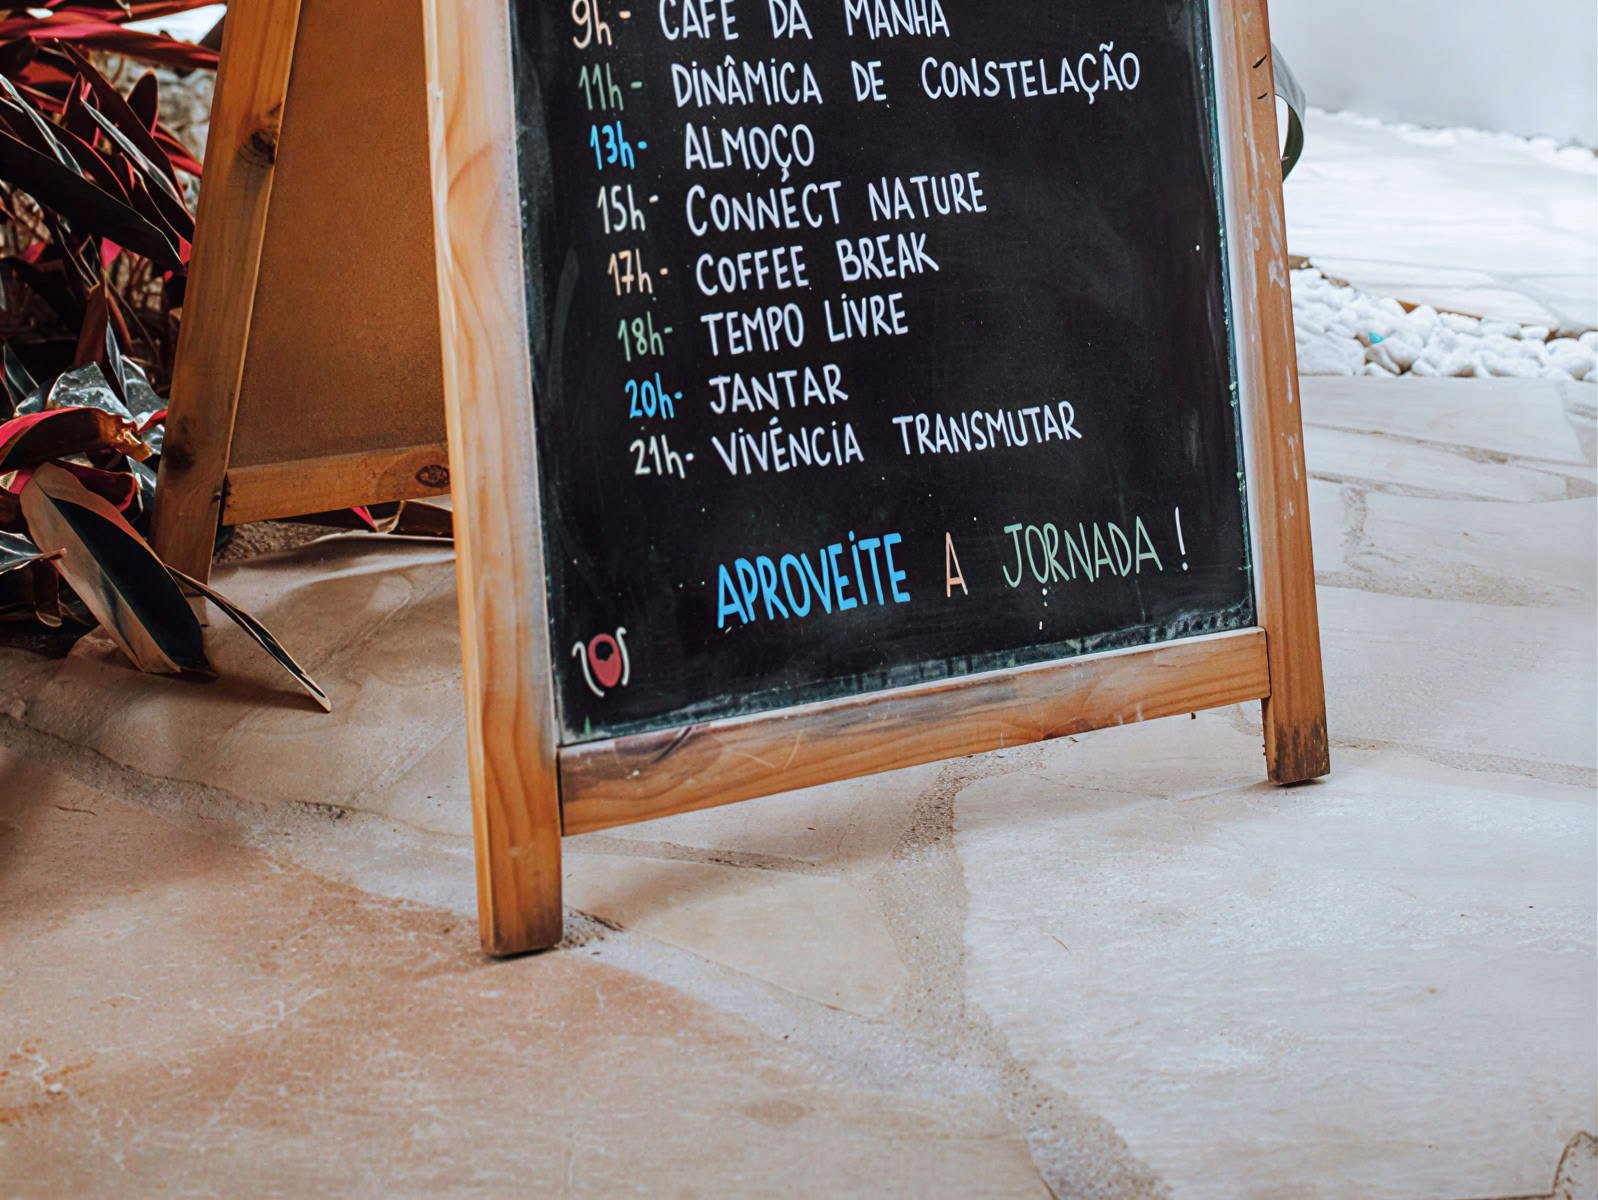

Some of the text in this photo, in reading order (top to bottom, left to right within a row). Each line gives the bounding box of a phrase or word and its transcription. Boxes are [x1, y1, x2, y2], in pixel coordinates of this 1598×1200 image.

[670, 54, 824, 108] DINÂMICA
[850, 60, 887, 102] DE
[920, 40, 1141, 105] CONSTELAÇÃO
[684, 122, 815, 183] ALMOÇO
[685, 179, 842, 237] CONNECT
[867, 171, 988, 222] NATURE
[695, 245, 810, 297] COFFEE
[835, 231, 940, 282] BREAK
[700, 302, 805, 357] TEMPO
[823, 291, 909, 343] LIVRE
[708, 363, 849, 415] JANTAR
[891, 400, 1083, 456] TRANSMUTAR
[717, 530, 911, 629] APROVEITE
[945, 531, 969, 598] A
[1002, 515, 1164, 588] JORNADA
